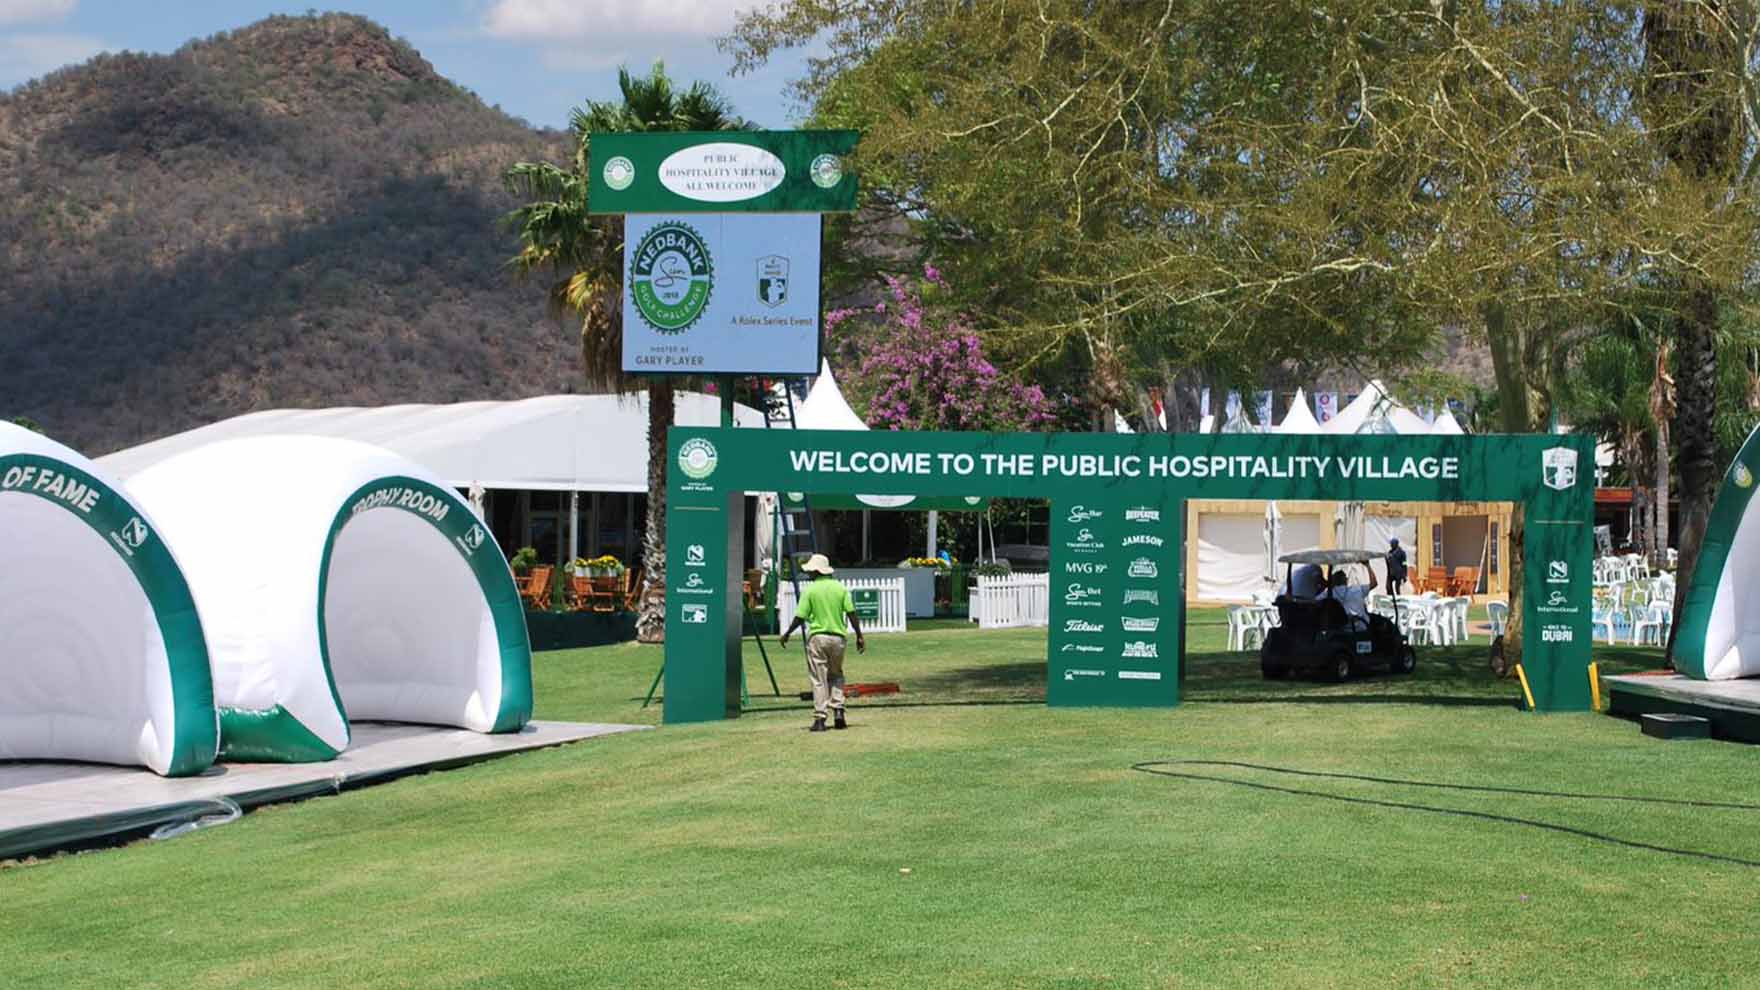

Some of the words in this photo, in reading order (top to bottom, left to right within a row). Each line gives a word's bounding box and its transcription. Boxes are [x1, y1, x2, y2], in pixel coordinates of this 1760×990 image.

[666, 168, 730, 177] HOSPITALITY
[705, 181, 756, 190] WELCOME
[639, 232, 705, 271] NEDBANK
[656, 286, 702, 320] CHALLENGE
[730, 316, 736, 324] A
[738, 317, 761, 325] Rolex
[763, 317, 788, 325] Series
[790, 317, 812, 326] Event
[635, 356, 663, 365] GARY
[665, 356, 704, 366] PLAYER
[790, 450, 931, 474] WELCOME
[937, 453, 974, 475] TO
[981, 453, 1033, 476] THE
[1041, 455, 1141, 477] PUBLIC
[1148, 456, 1330, 478] HOSPITALITY
[1338, 457, 1459, 479] VILLAGE
[2, 466, 37, 488] OF
[33, 468, 101, 513] FAME
[397, 489, 450, 521] ROOM
[1121, 535, 1164, 547] JAMESON
[1065, 562, 1093, 574] MVG
[1064, 619, 1104, 633] Titleist
[1541, 630, 1573, 642] DUBAI
